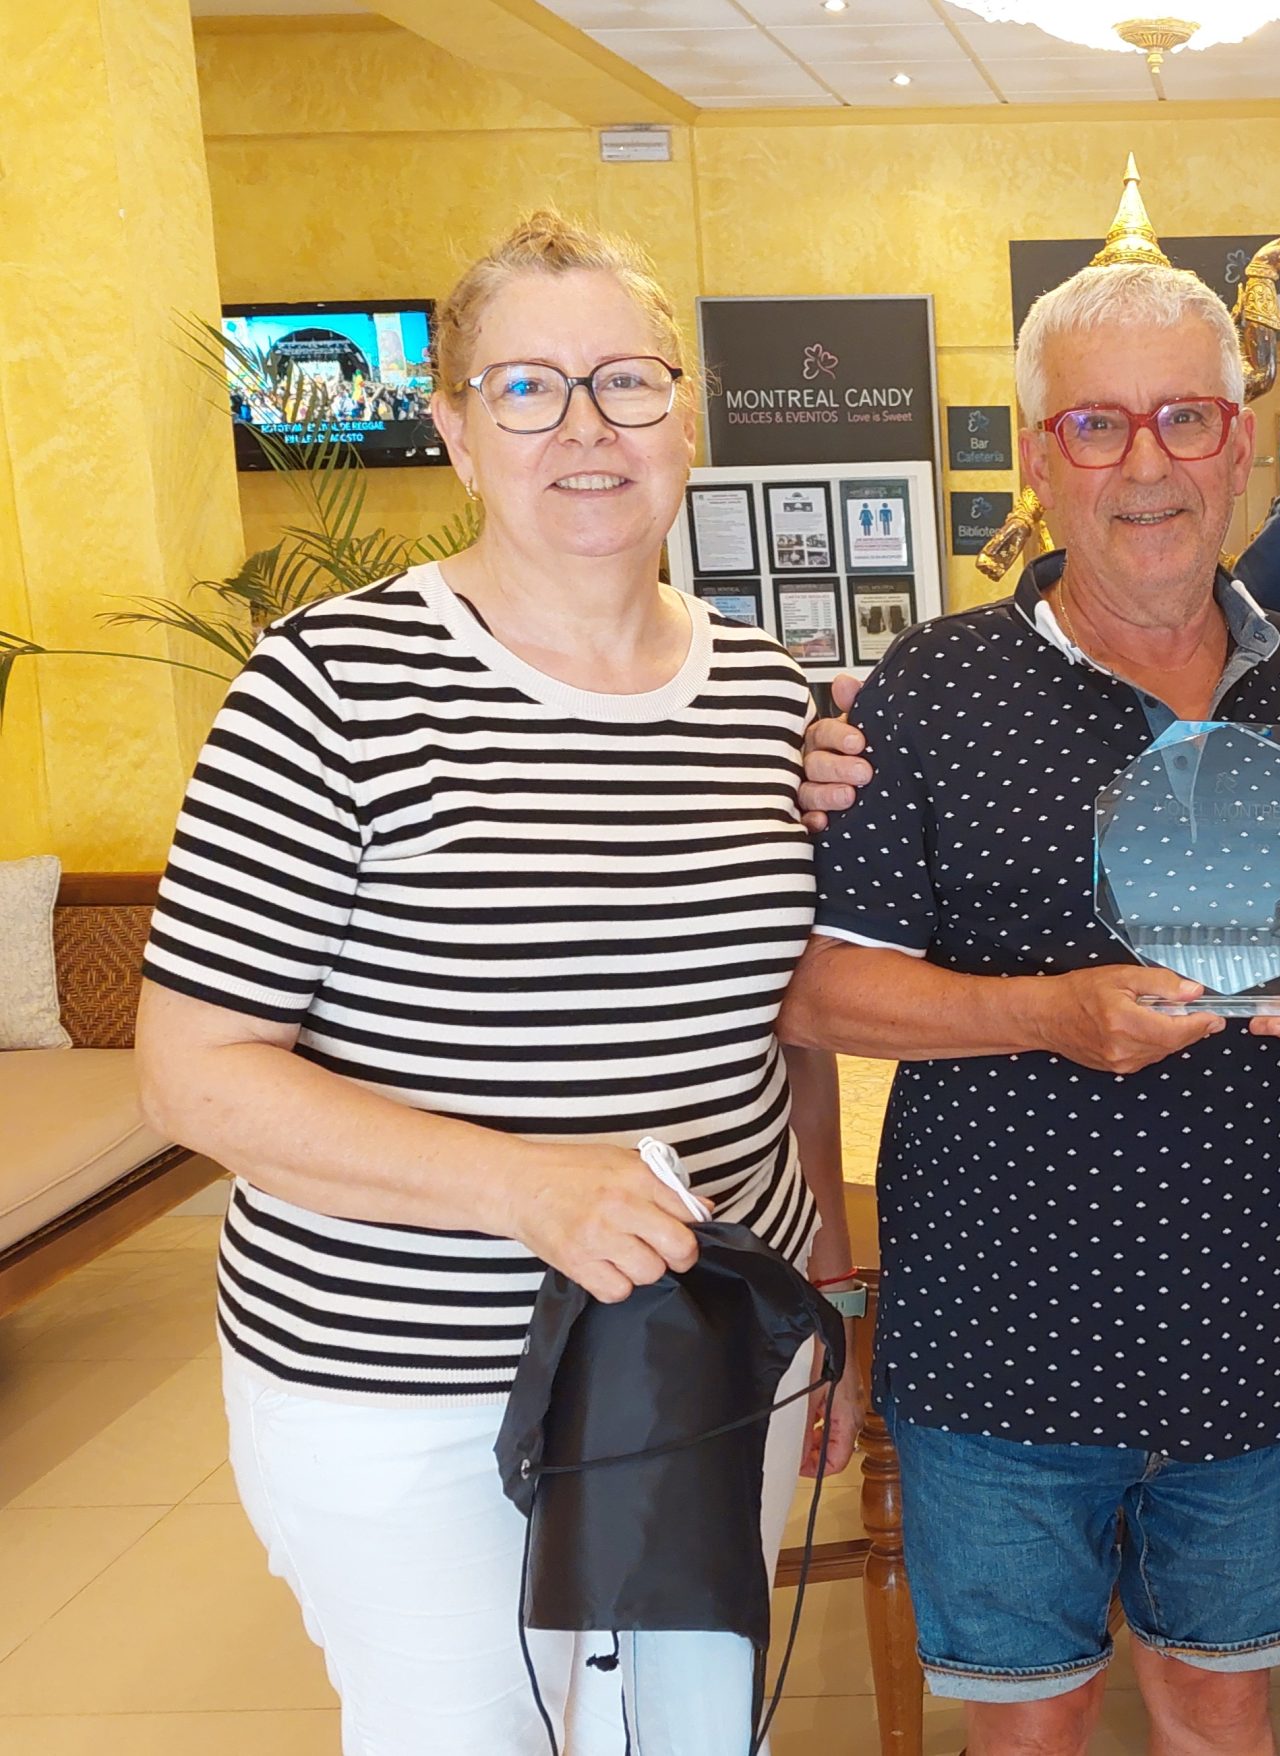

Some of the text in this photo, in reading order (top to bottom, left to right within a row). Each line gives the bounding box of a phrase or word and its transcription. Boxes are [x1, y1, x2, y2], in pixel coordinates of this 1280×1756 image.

[726, 387, 914, 409] MONTREAL CANDY
[728, 411, 773, 425] DULCES
[774, 411, 784, 423] &
[786, 410, 839, 424] EVENTOS
[847, 411, 870, 423] Love
[882, 410, 913, 423] Sweet
[970, 437, 990, 450] Bar
